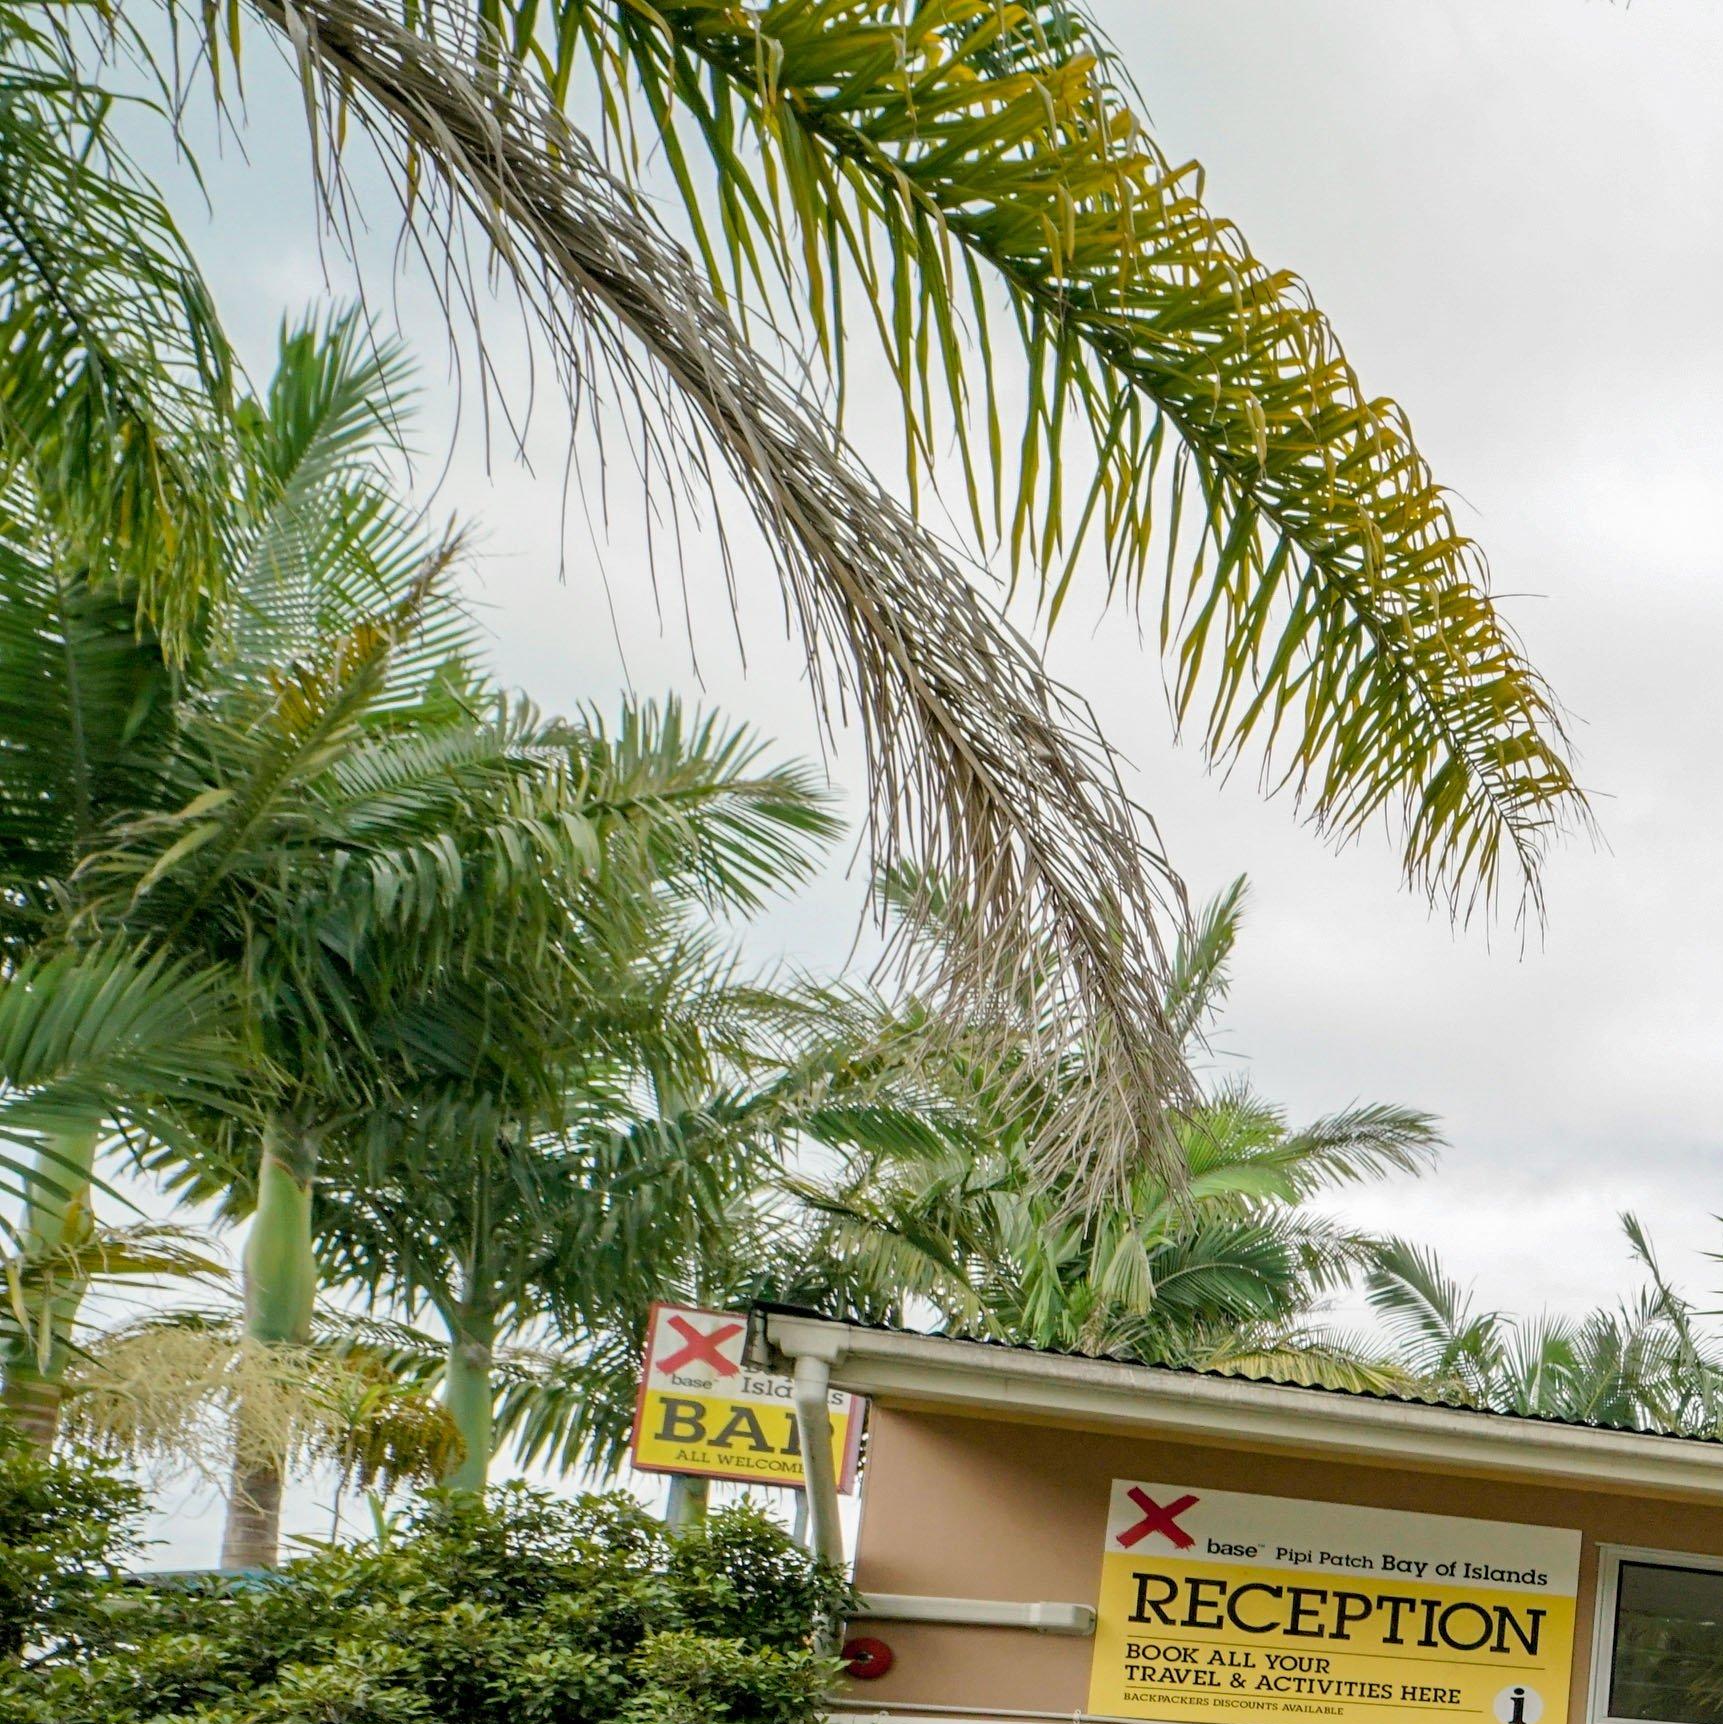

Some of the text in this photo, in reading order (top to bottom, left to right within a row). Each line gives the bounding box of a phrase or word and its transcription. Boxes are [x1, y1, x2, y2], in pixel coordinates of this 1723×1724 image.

[672, 1374, 712, 1389] base
[676, 1450, 711, 1463] ALL
[1207, 1538, 1548, 1586] base Pipi Patch Bay of Islands
[1128, 1572, 1547, 1655] RECEPTION
[1125, 1642, 1330, 1674] BOOK ALL YOUR
[1125, 1665, 1461, 1704] TRAVEL & ACTIVITIES HERE
[1124, 1693, 1344, 1716] BACKPACKERS DISCOUNTS AVAILABLE
